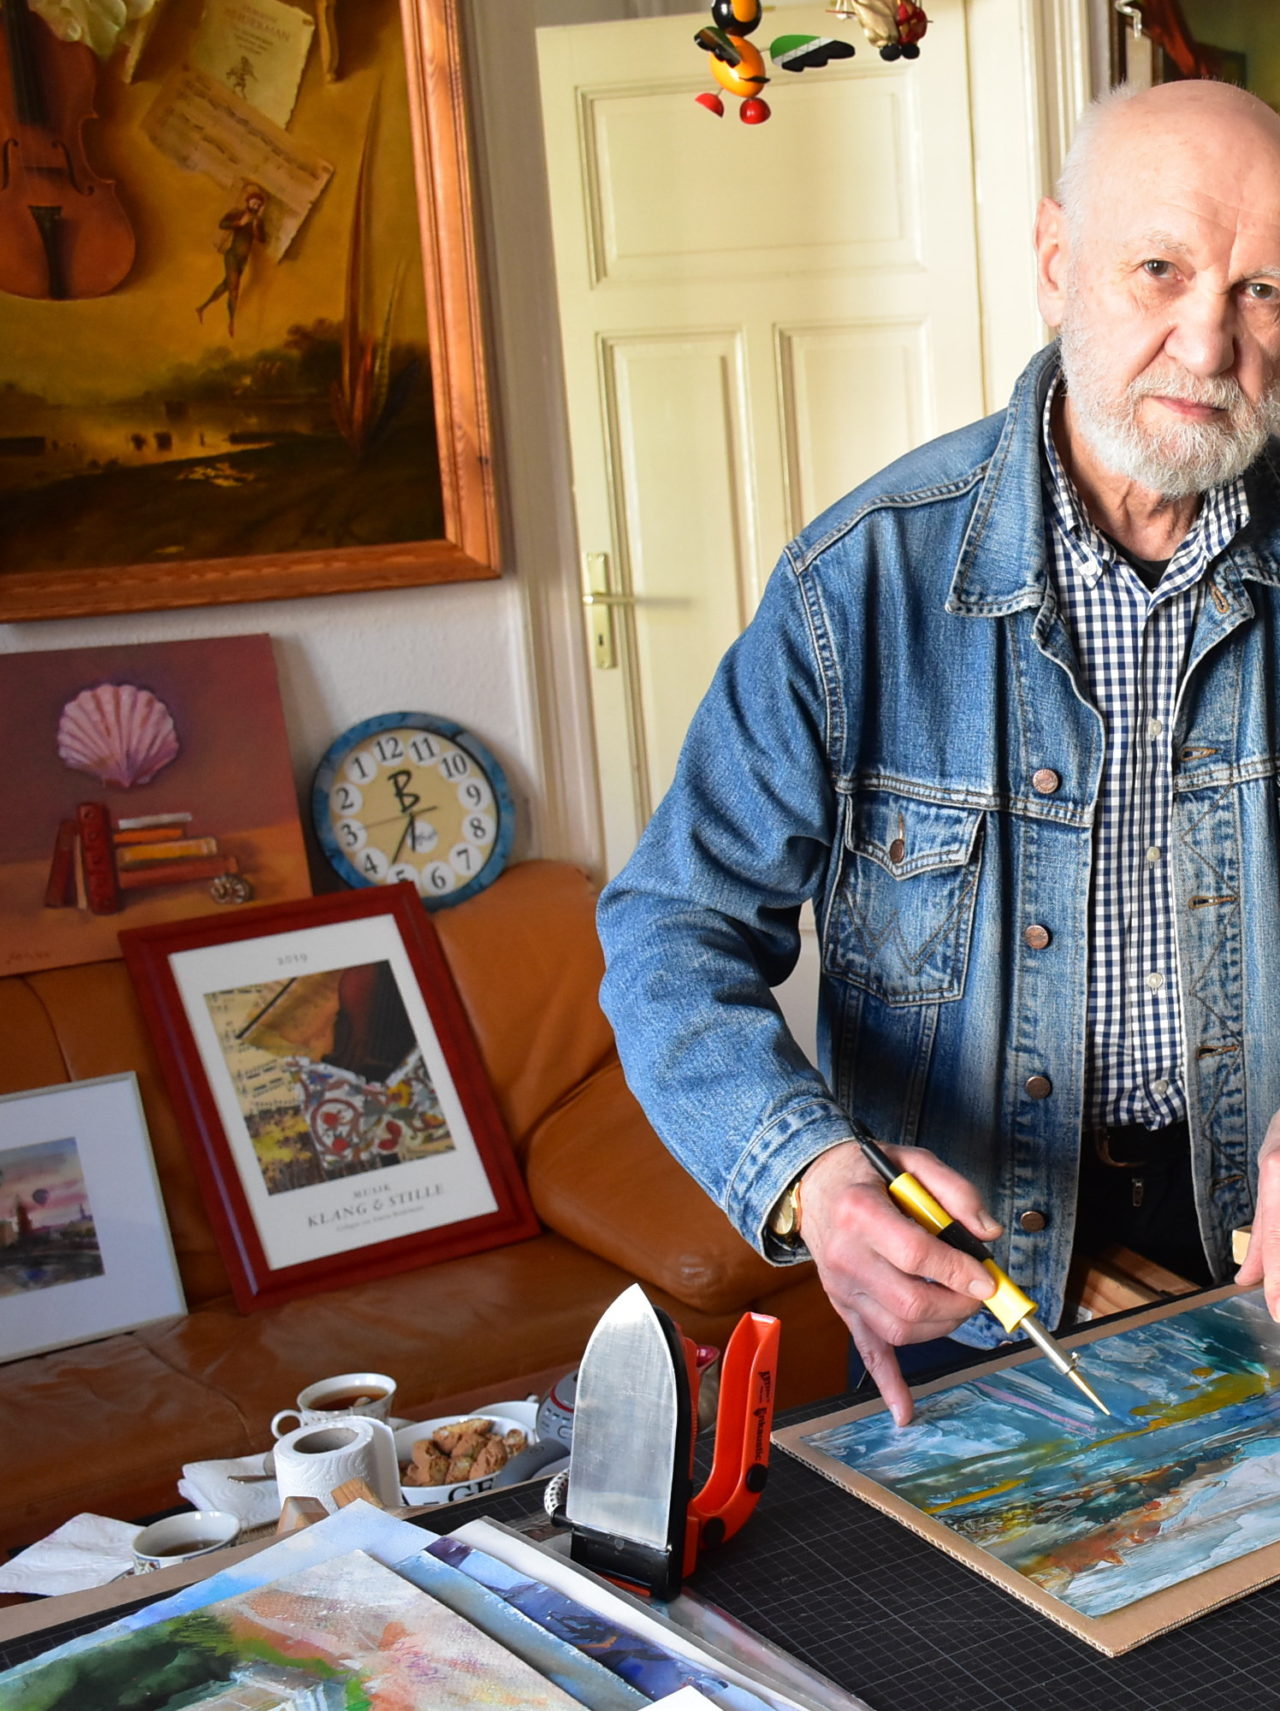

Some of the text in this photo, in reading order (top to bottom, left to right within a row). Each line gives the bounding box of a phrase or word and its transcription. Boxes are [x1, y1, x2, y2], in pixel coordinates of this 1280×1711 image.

[374, 736, 404, 762] 12
[410, 737, 437, 762] 11
[352, 757, 368, 779] 1
[441, 752, 468, 779] 10
[335, 787, 354, 810] 2
[466, 783, 482, 806] 9
[340, 823, 358, 847] 3
[469, 817, 487, 842] 8
[362, 853, 379, 880] 4
[456, 848, 472, 871] 7
[430, 866, 447, 890] 6
[277, 952, 308, 966] 2019
[307, 1203, 367, 1228] KLANG
[389, 1183, 444, 1207] STILLE
